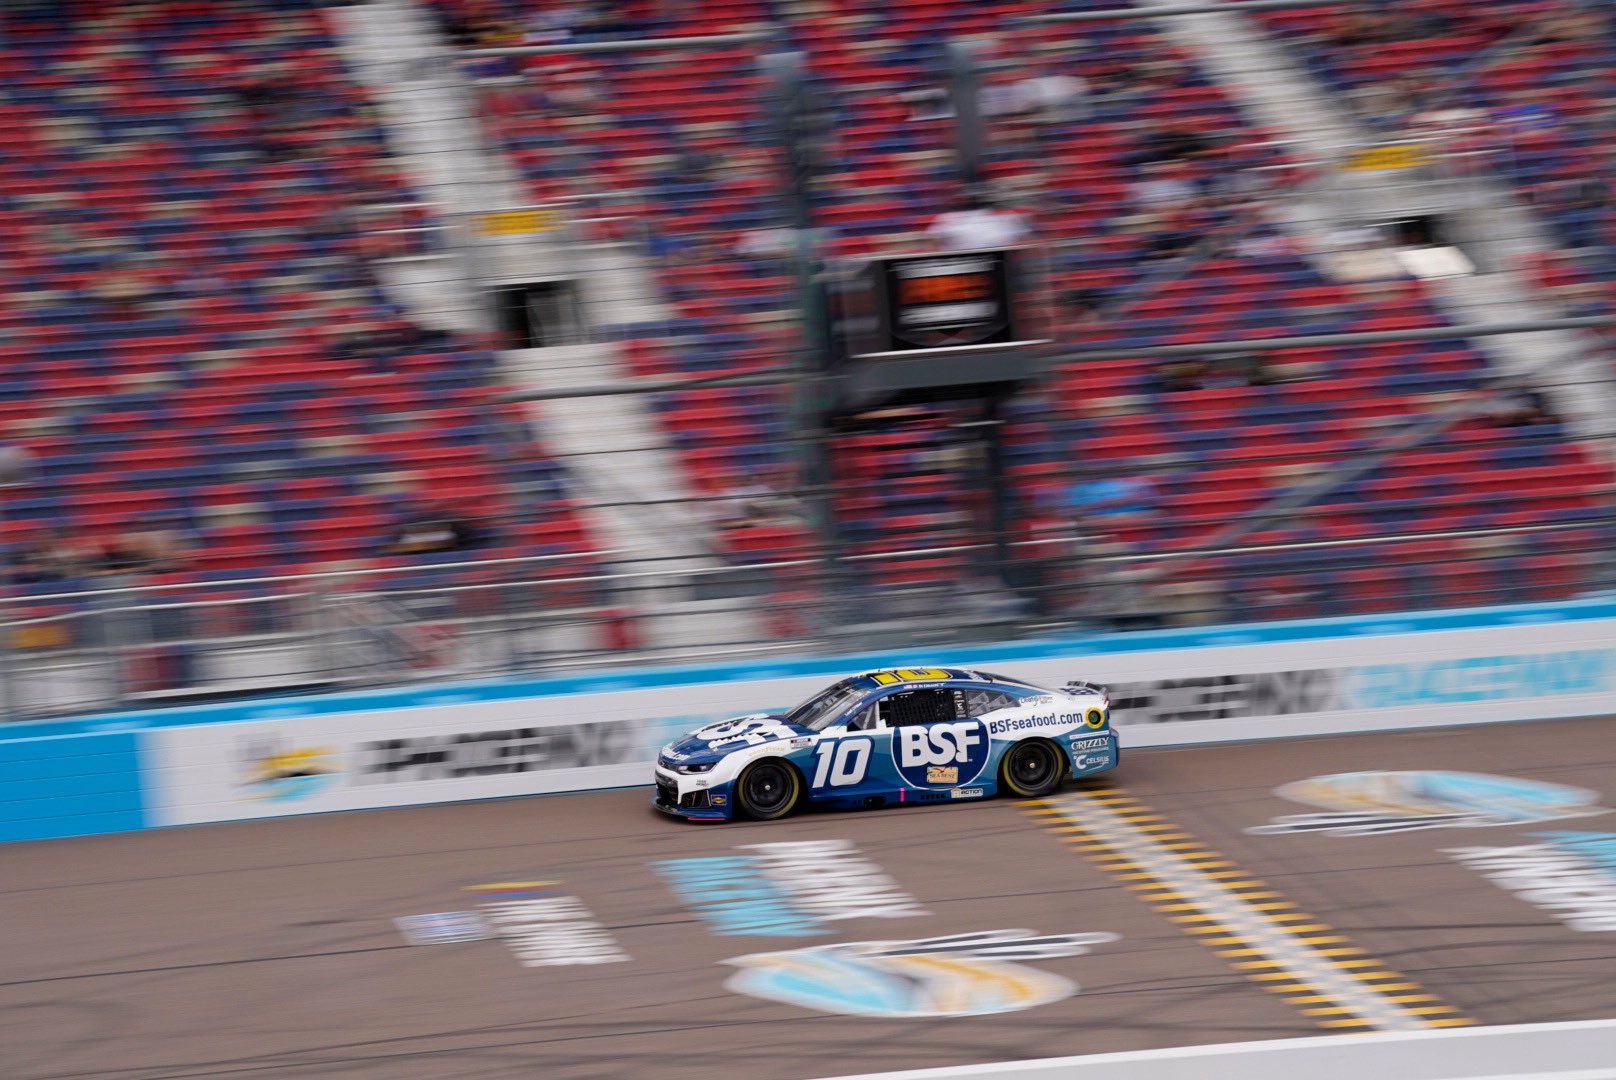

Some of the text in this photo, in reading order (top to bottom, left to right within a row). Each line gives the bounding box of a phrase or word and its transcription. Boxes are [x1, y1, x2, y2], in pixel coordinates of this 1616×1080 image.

[989, 712, 1083, 735] BSFseafood.com
[899, 722, 980, 768] BSF
[1071, 737, 1109, 750] GRIZZLY
[812, 738, 872, 788] 10
[1086, 756, 1109, 764] CELSIUS
